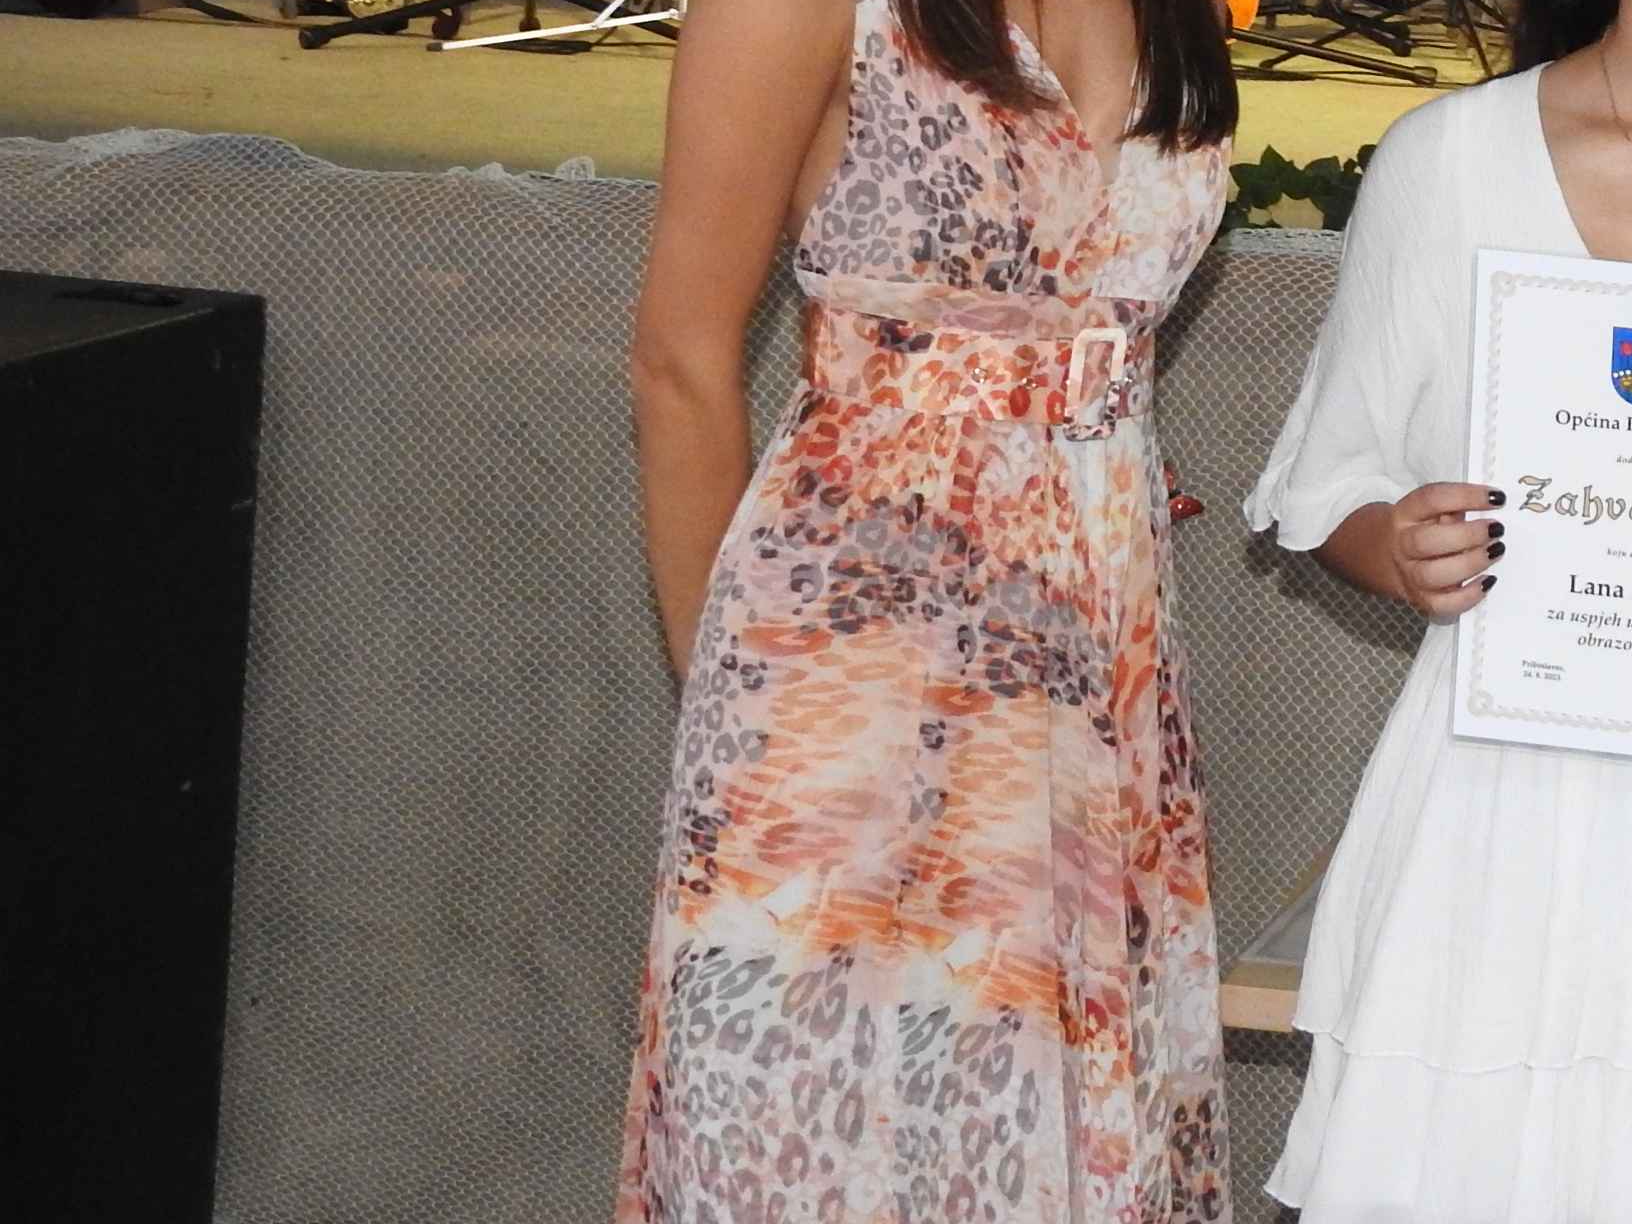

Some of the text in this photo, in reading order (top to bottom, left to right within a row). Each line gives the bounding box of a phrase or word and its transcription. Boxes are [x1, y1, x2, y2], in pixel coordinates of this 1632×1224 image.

[1555, 409, 1620, 431] Općina
[1569, 574, 1624, 598] Lana
[1547, 608, 1565, 621] za
[1569, 612, 1622, 629] uspjeh
